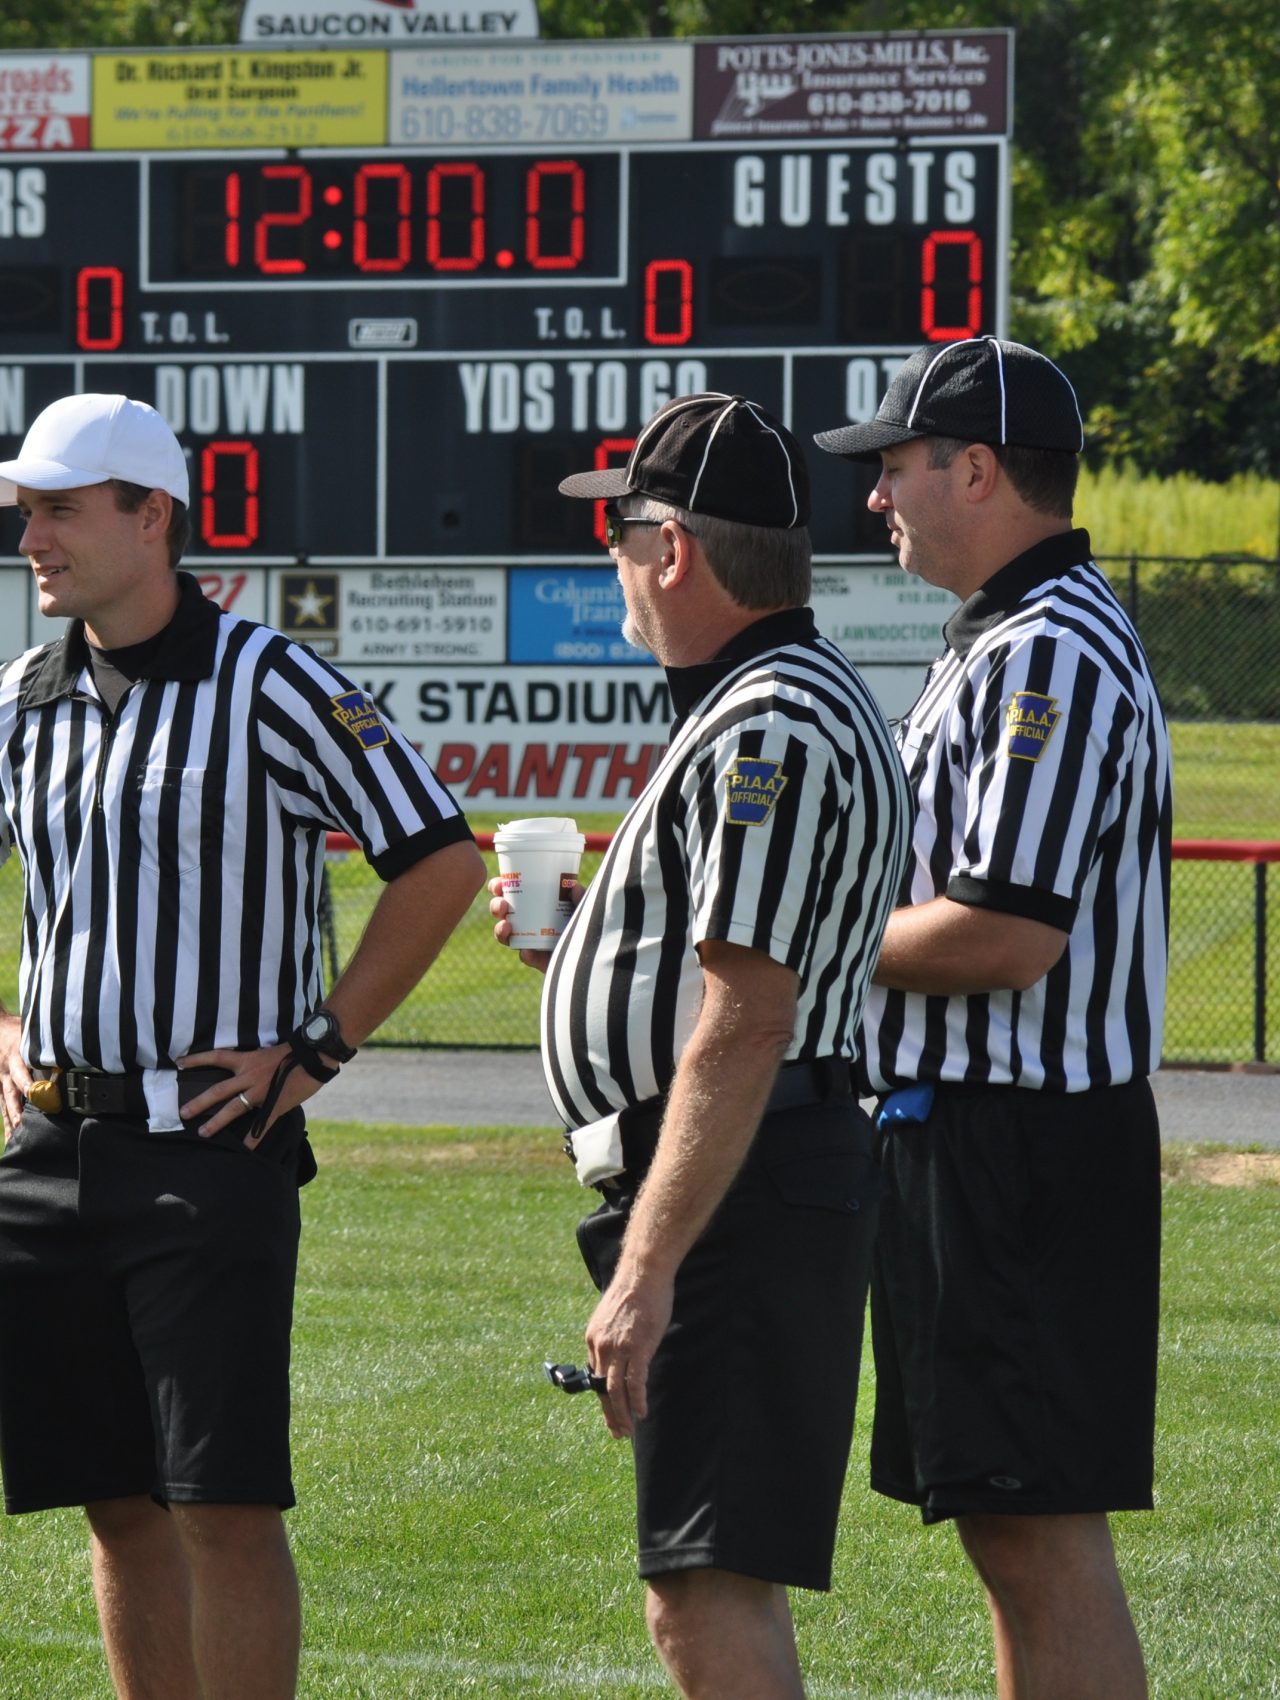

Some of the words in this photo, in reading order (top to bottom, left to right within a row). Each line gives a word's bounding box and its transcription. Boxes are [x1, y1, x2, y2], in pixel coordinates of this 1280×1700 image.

[256, 12, 391, 37] SAUCON
[402, 10, 518, 35] VALLEY
[952, 39, 990, 64] Inc.
[115, 60, 142, 82] Dr.
[147, 59, 223, 81] Richard
[230, 58, 244, 80] T.
[250, 58, 335, 81] Kingston
[340, 57, 366, 79] Jr.
[802, 70, 900, 89] Insurance
[904, 65, 987, 86] Services
[186, 85, 219, 100] Oral
[227, 84, 300, 101] Surgeon
[401, 75, 524, 97] Hellertown
[530, 71, 602, 99] Family
[606, 71, 680, 94] Health
[400, 103, 610, 140] 610-838-7069
[733, 151, 977, 228] GUESTS
[225, 160, 584, 274] 12:00.0
[921, 230, 983, 342] 0
[77, 267, 123, 350] 0
[644, 259, 693, 345] 0
[155, 363, 305, 435] DOWN
[457, 361, 555, 434] YDS
[567, 360, 628, 432] TO
[201, 441, 259, 548] 0
[370, 573, 475, 590] Bethlehem
[534, 577, 624, 604] Columb
[347, 591, 434, 610] Recruiting
[439, 591, 496, 607] Station
[349, 616, 493, 634] 610-691-5910
[362, 641, 409, 656] ARMY
[419, 680, 671, 724] STADIUM
[1009, 724, 1046, 741] OFFICIAL
[436, 743, 668, 798] PANTH
[731, 790, 773, 806] OFFICIAL
